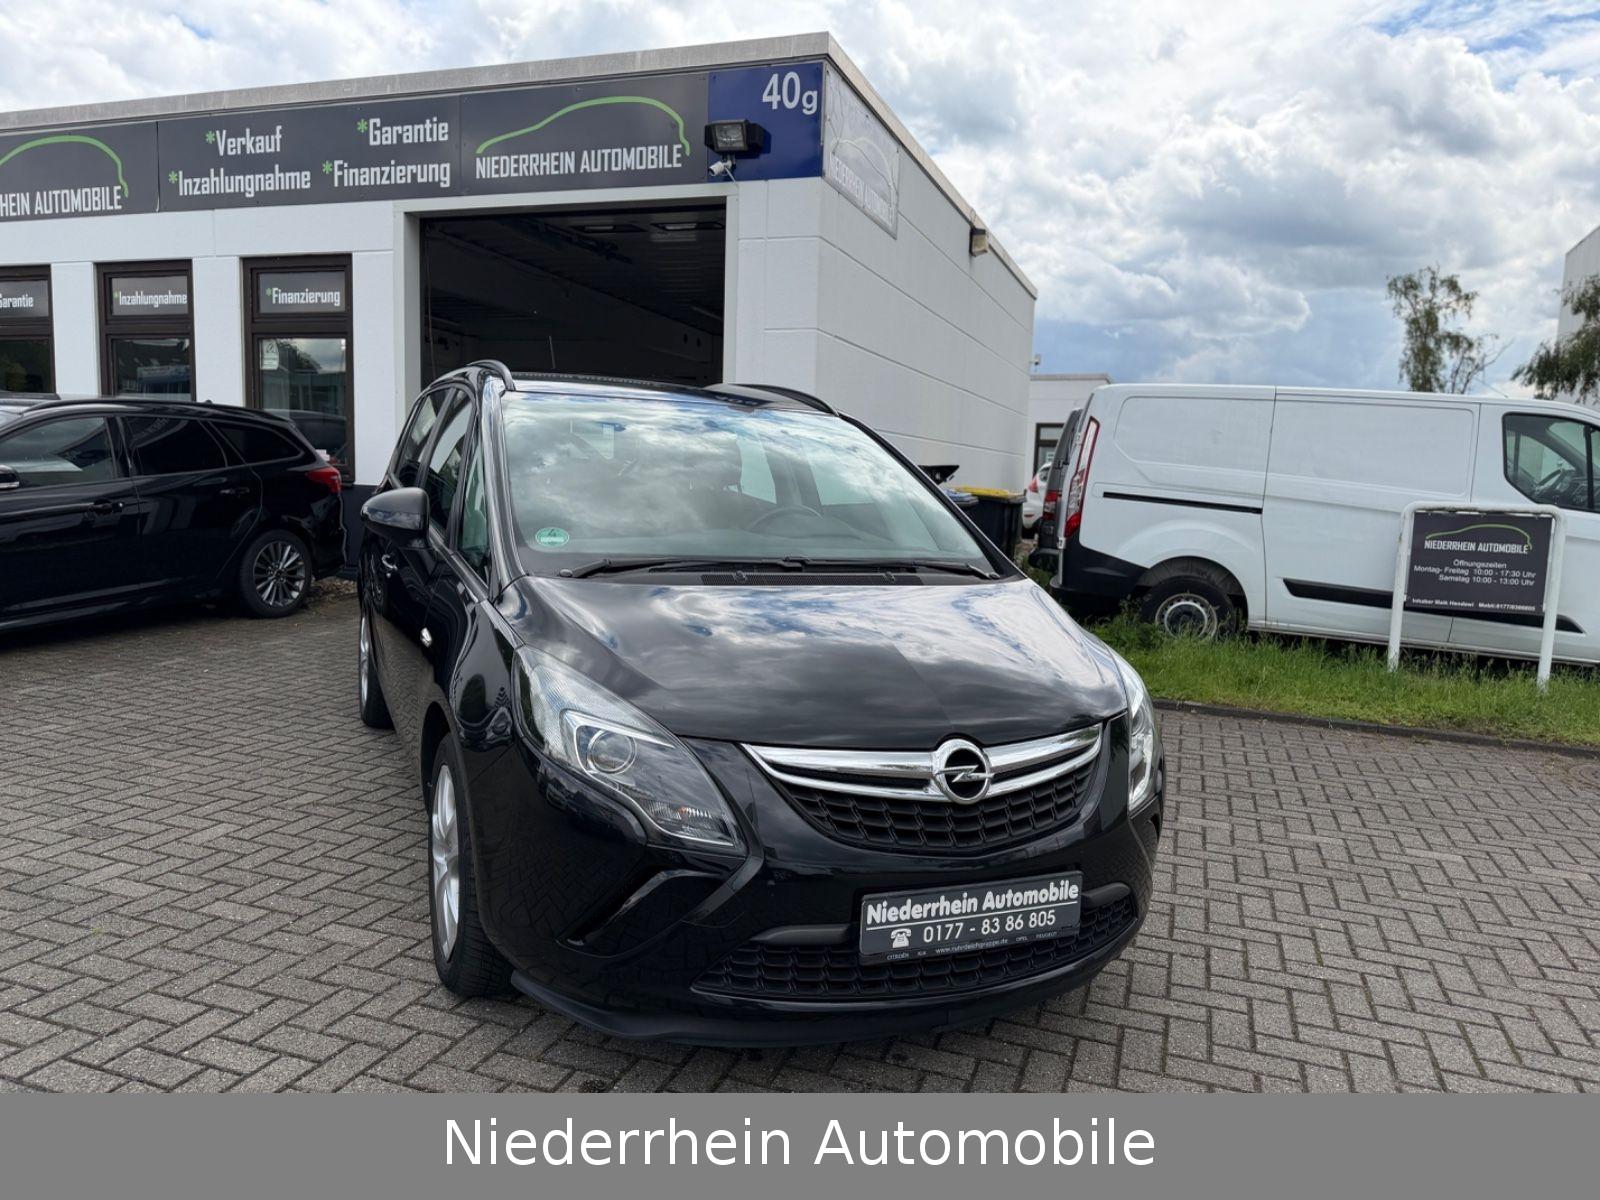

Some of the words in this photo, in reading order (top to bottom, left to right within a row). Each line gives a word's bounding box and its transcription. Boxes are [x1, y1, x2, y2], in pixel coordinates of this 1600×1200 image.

[762, 71, 818, 115] 40g
[215, 125, 282, 156] Verkauf
[369, 116, 449, 146] Garantie
[333, 159, 451, 188] Finanzierung
[475, 151, 575, 179] NIEDERRHEIN
[579, 144, 683, 173] AUTOMOBILE
[178, 163, 312, 198] Inzahlungnahme
[34, 185, 123, 215] AUTOMOBILE
[118, 290, 187, 308] Inzahlungnahme
[271, 287, 341, 307] Finanzierung
[1424, 540, 1476, 551] NIEDERRHEIN
[1478, 543, 1529, 555] AUTOMOBILE
[1439, 574, 1470, 584] Samstag
[1444, 567, 1470, 576] Freitag
[1522, 571, 1537, 579] Uhr
[866, 892, 978, 925] Niederrhein
[982, 880, 1079, 911] Automobile
[923, 923, 964, 943] 0177
[981, 917, 1000, 935] 83
[1005, 913, 1024, 931] 86
[1029, 910, 1056, 928] 805
